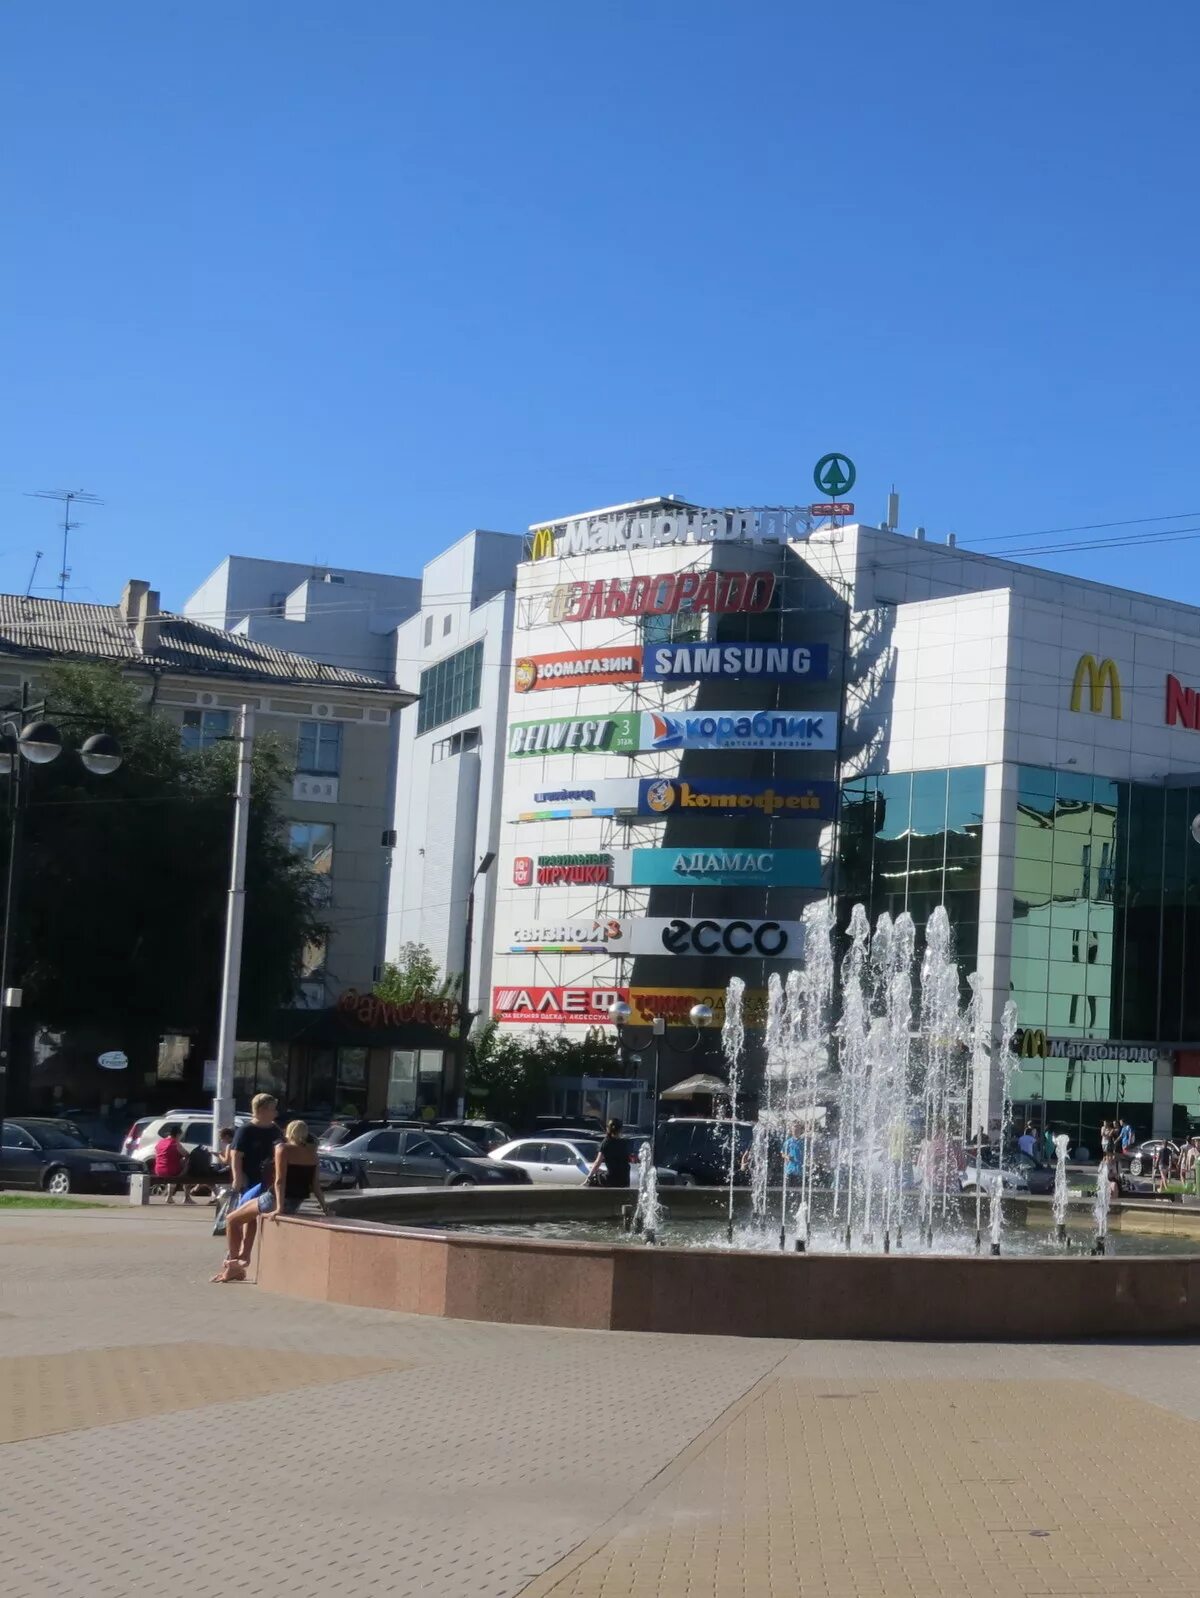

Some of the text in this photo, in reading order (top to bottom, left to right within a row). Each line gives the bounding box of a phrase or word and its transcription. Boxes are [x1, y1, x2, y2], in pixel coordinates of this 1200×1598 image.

[562, 510, 815, 555] Макдоналдс
[537, 657, 633, 678] ЗООМАГАЗИН
[655, 647, 811, 674] SAMSUNG
[510, 719, 611, 752] BELWEST
[621, 720, 630, 735] 3
[680, 783, 820, 814] котофей
[538, 853, 612, 867] ПРАВИЛЬНЫЕ
[672, 853, 774, 873] АДАМАС
[538, 866, 609, 884] ИГРУШКИ
[662, 920, 788, 957] ecco
[514, 990, 618, 1012] АЛЕФ
[1051, 1041, 1158, 1063] Макдоналдс
